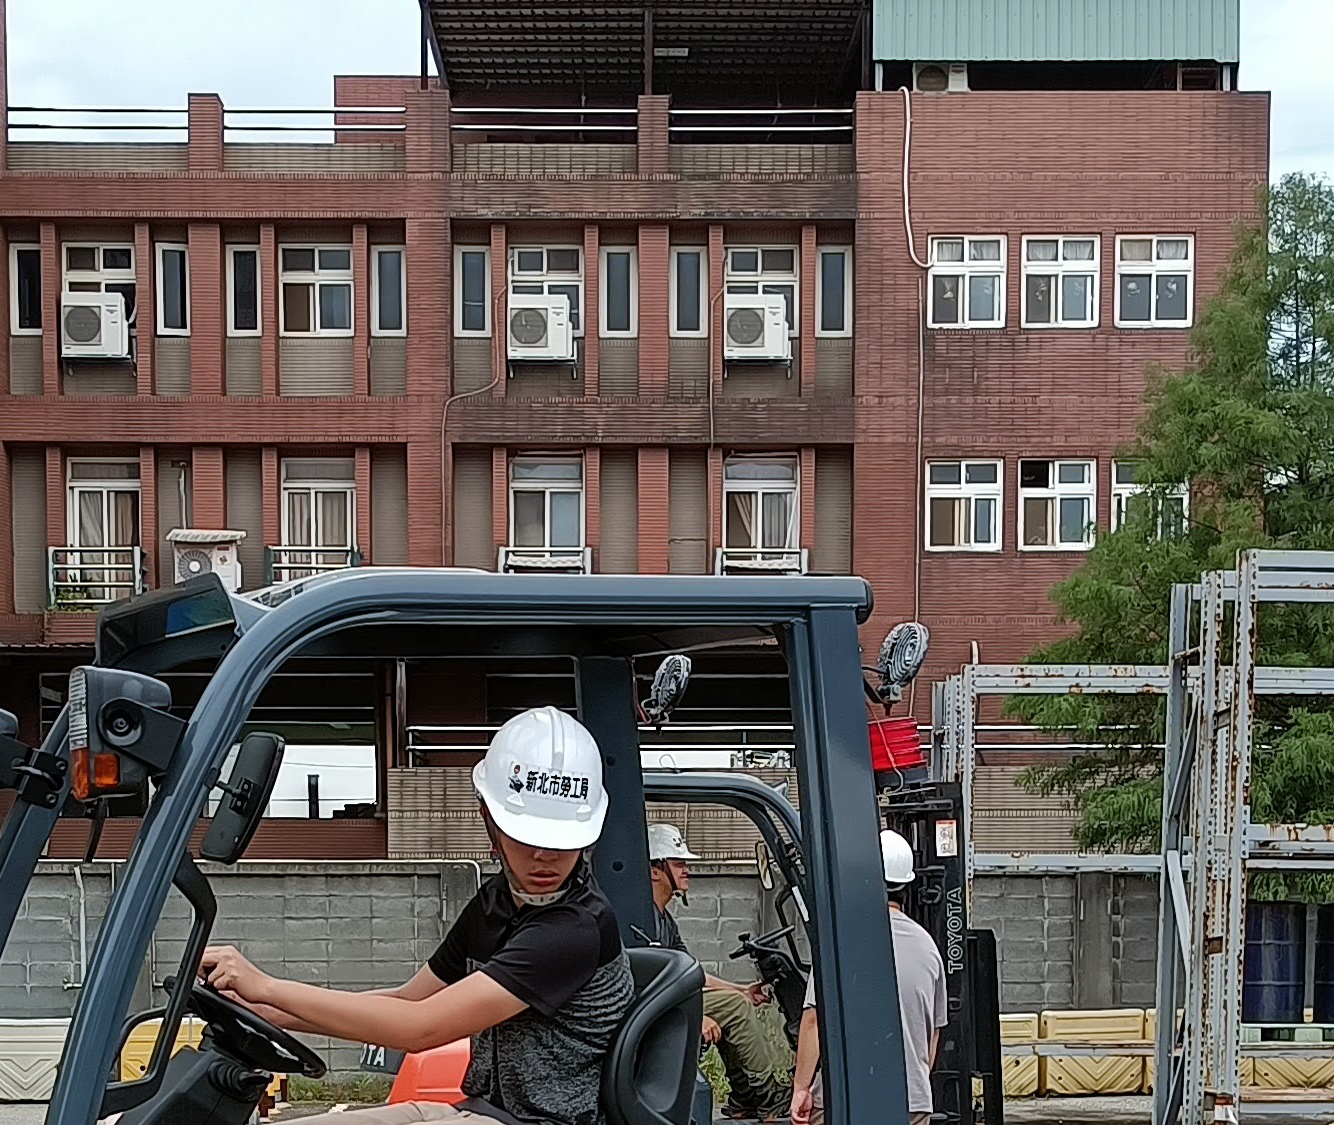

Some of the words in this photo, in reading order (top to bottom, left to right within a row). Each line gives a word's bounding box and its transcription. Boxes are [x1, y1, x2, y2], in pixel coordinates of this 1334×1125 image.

[526, 771, 589, 800] 新北市勞工局
[947, 887, 964, 974] TOYOTA
